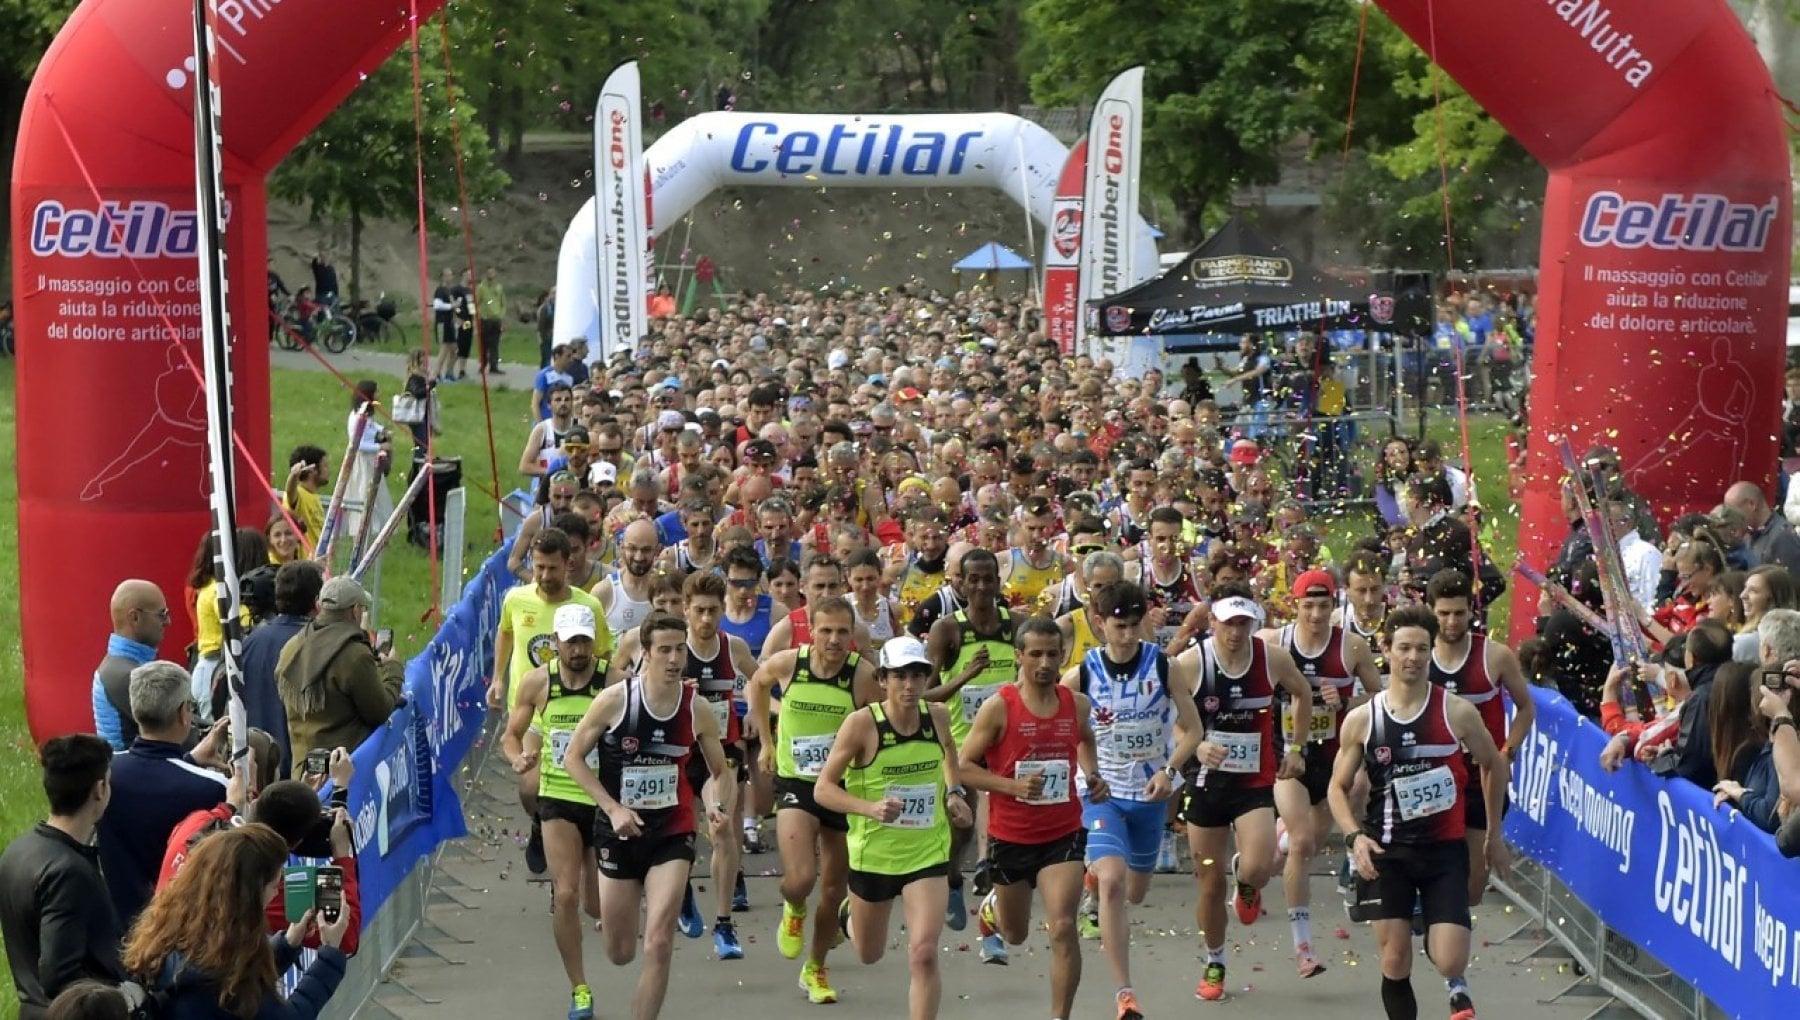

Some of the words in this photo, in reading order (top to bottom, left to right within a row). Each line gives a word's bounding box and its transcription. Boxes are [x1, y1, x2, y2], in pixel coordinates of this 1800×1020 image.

[1547, 0, 1652, 88] aNutra
[731, 121, 984, 177] Cetilar
[31, 200, 231, 259] Cetila
[1579, 190, 1779, 253] Cetilar
[50, 276, 132, 296] massaggio
[137, 279, 169, 293] con
[1584, 266, 1593, 281] Il
[1597, 267, 1686, 288] massaggio
[1691, 273, 1721, 286] con
[59, 300, 97, 317] aiuta
[102, 299, 118, 317] la
[122, 301, 202, 317] riduzione
[1606, 289, 1648, 307] aiuta
[1653, 291, 1669, 309] la
[1674, 293, 1748, 310] riduzione
[1252, 299, 1352, 327] TRIATHLON
[1591, 312, 1615, 330] del
[1619, 313, 1676, 332] dolore
[48, 322, 68, 338] del
[72, 323, 126, 341] dolore
[131, 324, 202, 340] articolar
[1127, 732, 1153, 749] 593
[804, 746, 830, 762] 330
[638, 777, 665, 796] 491
[1412, 783, 1444, 804] 552
[1585, 784, 1635, 874] moving
[1655, 789, 1747, 971] Cetilar
[1754, 880, 1787, 987] keep
